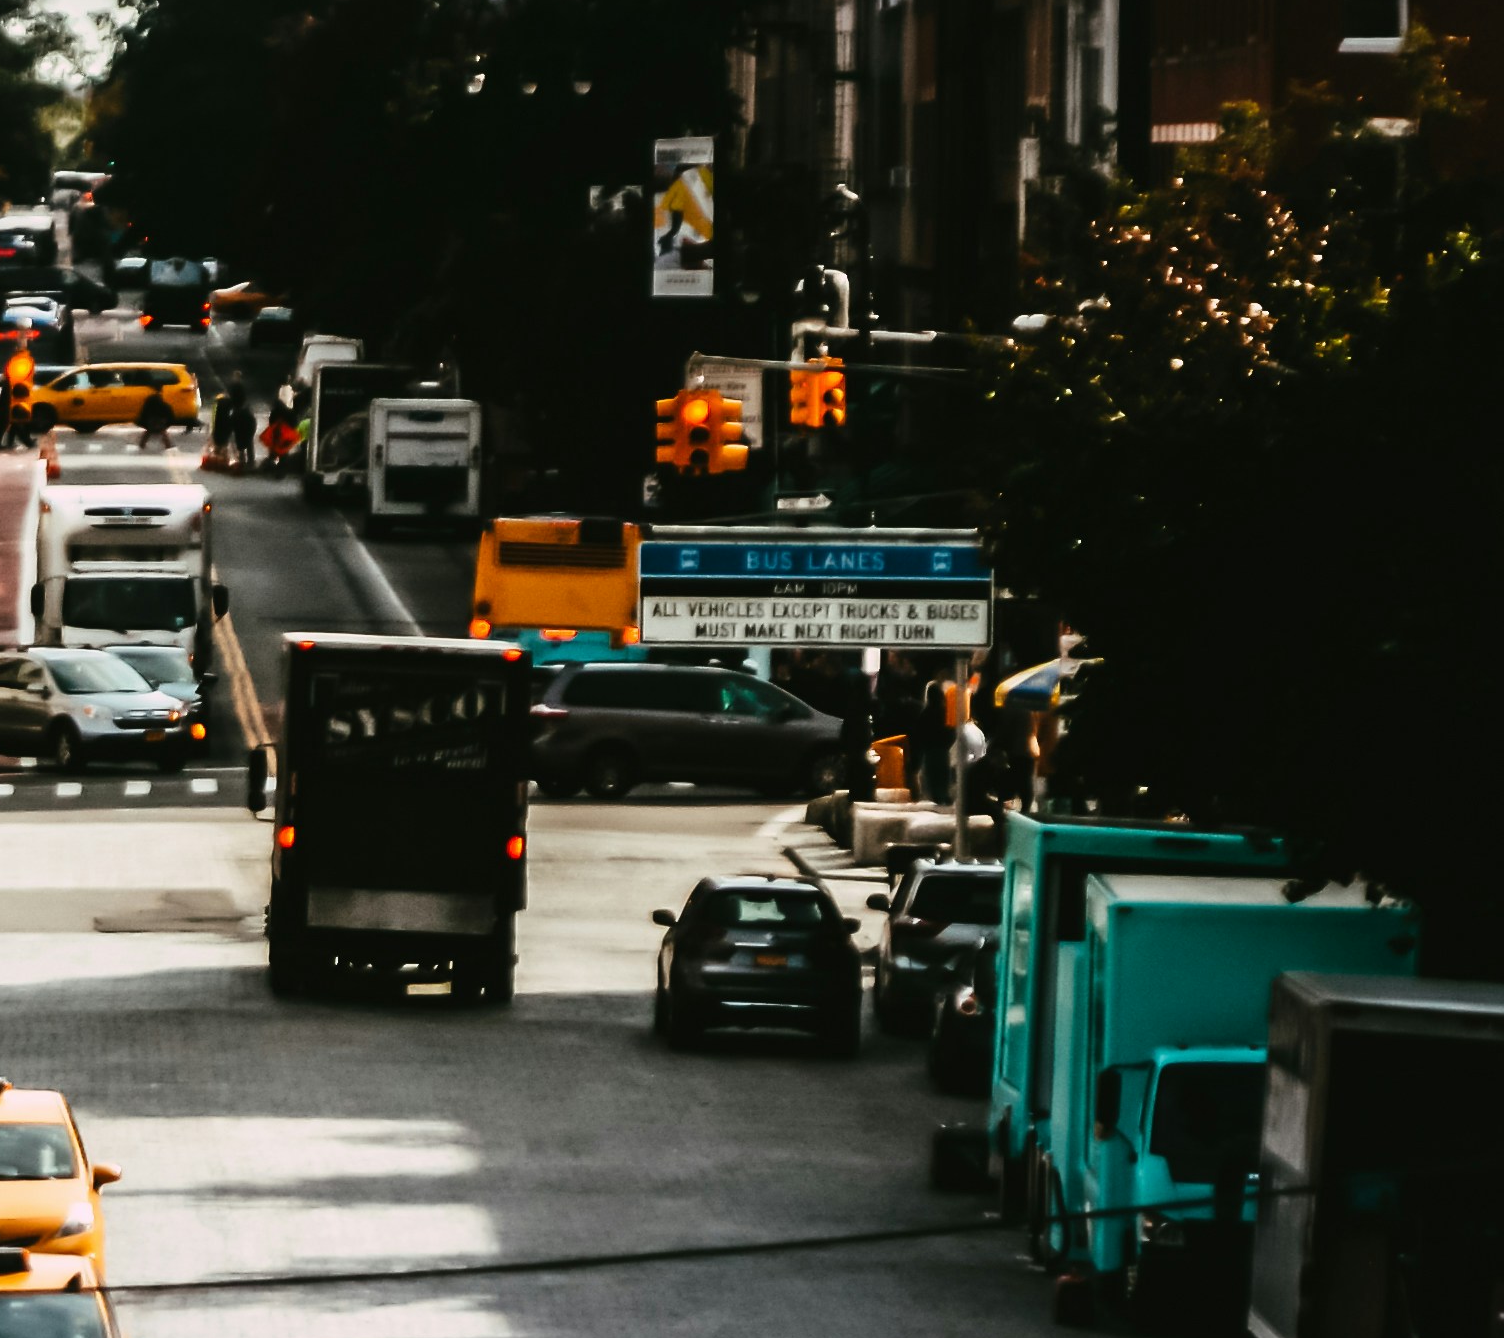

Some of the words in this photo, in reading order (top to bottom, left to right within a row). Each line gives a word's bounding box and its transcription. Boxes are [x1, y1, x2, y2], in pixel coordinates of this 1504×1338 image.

[746, 551, 793, 570] BUS
[807, 552, 886, 571] LANES
[651, 602, 680, 618] ALL
[689, 602, 765, 619] VEHICLES
[772, 602, 831, 619] EXCEPT
[841, 603, 900, 619] TRUCKS
[906, 603, 920, 619] &
[927, 603, 980, 620] BUSES
[695, 622, 738, 639] MUST
[745, 623, 788, 639] MAKE
[795, 624, 833, 640] NEXT
[841, 624, 887, 640] RIGHT
[894, 624, 935, 640] TURN
